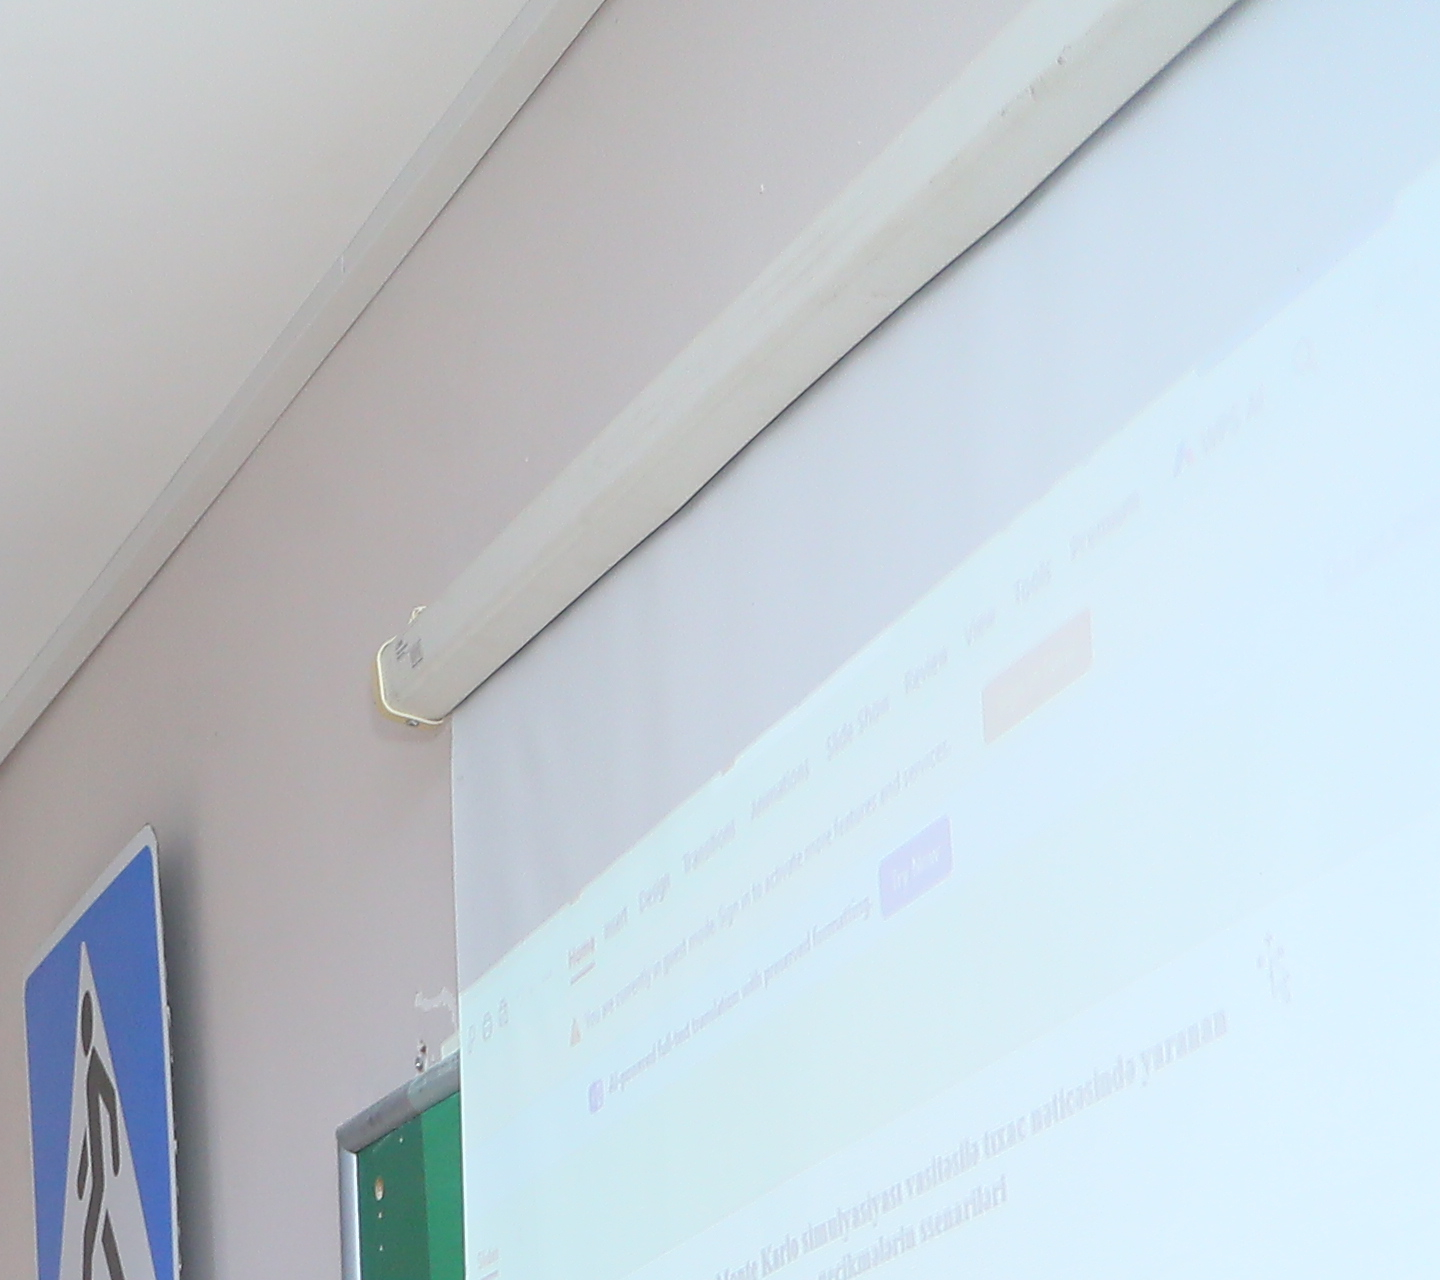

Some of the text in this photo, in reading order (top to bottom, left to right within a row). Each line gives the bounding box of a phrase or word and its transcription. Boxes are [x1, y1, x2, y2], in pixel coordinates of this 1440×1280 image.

[904, 647, 948, 694] Review
[826, 697, 889, 761] Slide Show
[639, 873, 670, 914] Design
[568, 936, 595, 969] Home
[760, 1233, 799, 1278] Karlo
[801, 1181, 902, 1255] simulyasiyası
[905, 1133, 980, 1200] vasitəsilə
[982, 1115, 1027, 1159] tıxac
[1030, 1054, 1136, 1136] nəticəsində
[1140, 1008, 1228, 1088] yaranan
[919, 1173, 1008, 1244] ssenariləri
